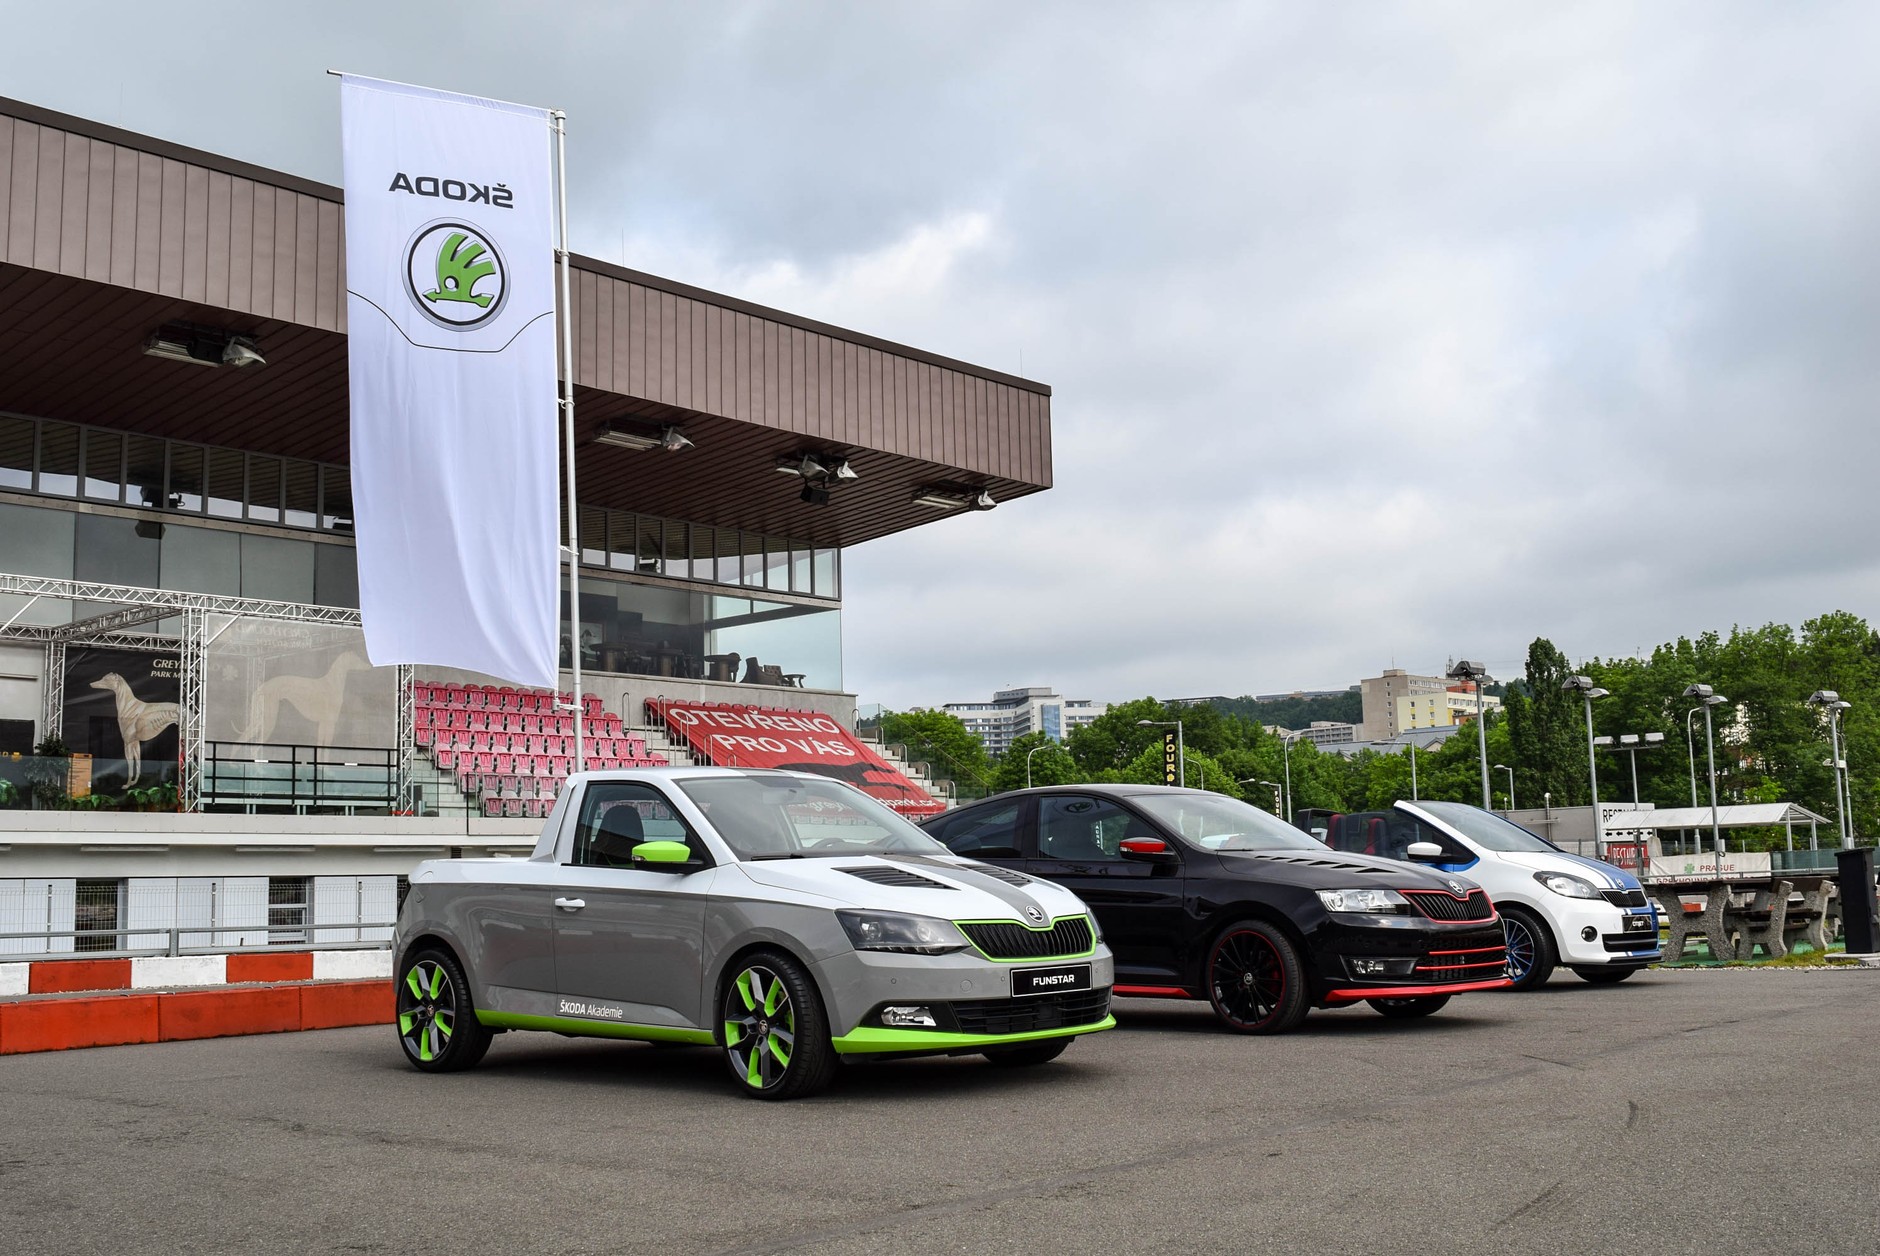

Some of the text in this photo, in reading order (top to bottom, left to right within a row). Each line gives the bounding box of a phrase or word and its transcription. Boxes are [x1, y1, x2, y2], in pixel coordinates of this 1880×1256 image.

[150, 670, 171, 678] PARK
[669, 708, 840, 734] OTEVŘENO
[711, 734, 856, 757] PRO VÁS
[1165, 734, 1176, 772] FOUR
[1033, 974, 1075, 986] FUNSTAR
[559, 999, 623, 1019] ŠKODA Akademie
